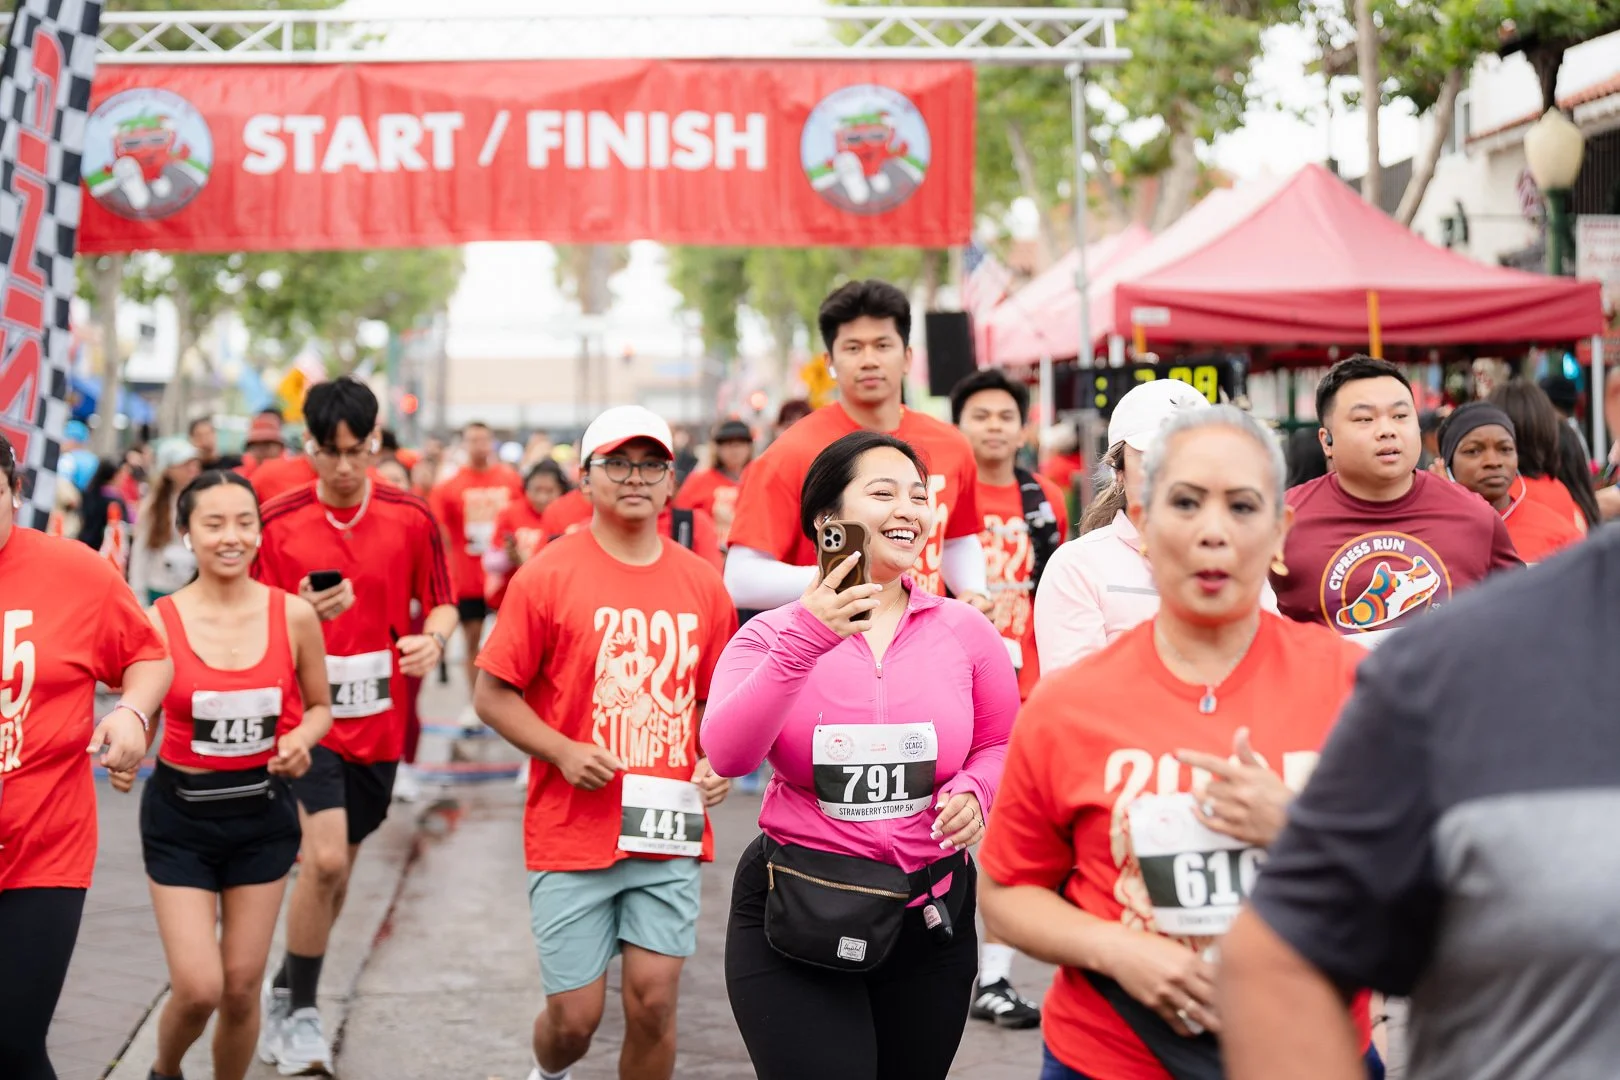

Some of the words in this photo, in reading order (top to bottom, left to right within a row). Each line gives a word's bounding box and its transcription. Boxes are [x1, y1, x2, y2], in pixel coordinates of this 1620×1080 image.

[242, 112, 463, 175] START
[477, 109, 511, 168] /
[526, 109, 767, 171] FINISH
[1328, 541, 1371, 591] CYPRESS
[1372, 537, 1406, 552] RUN
[592, 606, 700, 718] 2025
[335, 678, 380, 704] 486
[210, 718, 264, 743] 445
[842, 764, 909, 803] 791
[639, 808, 687, 841] 441
[838, 806, 881, 817] STRAWBERRY
[882, 804, 904, 815] STOMP
[905, 803, 914, 812] 5K
